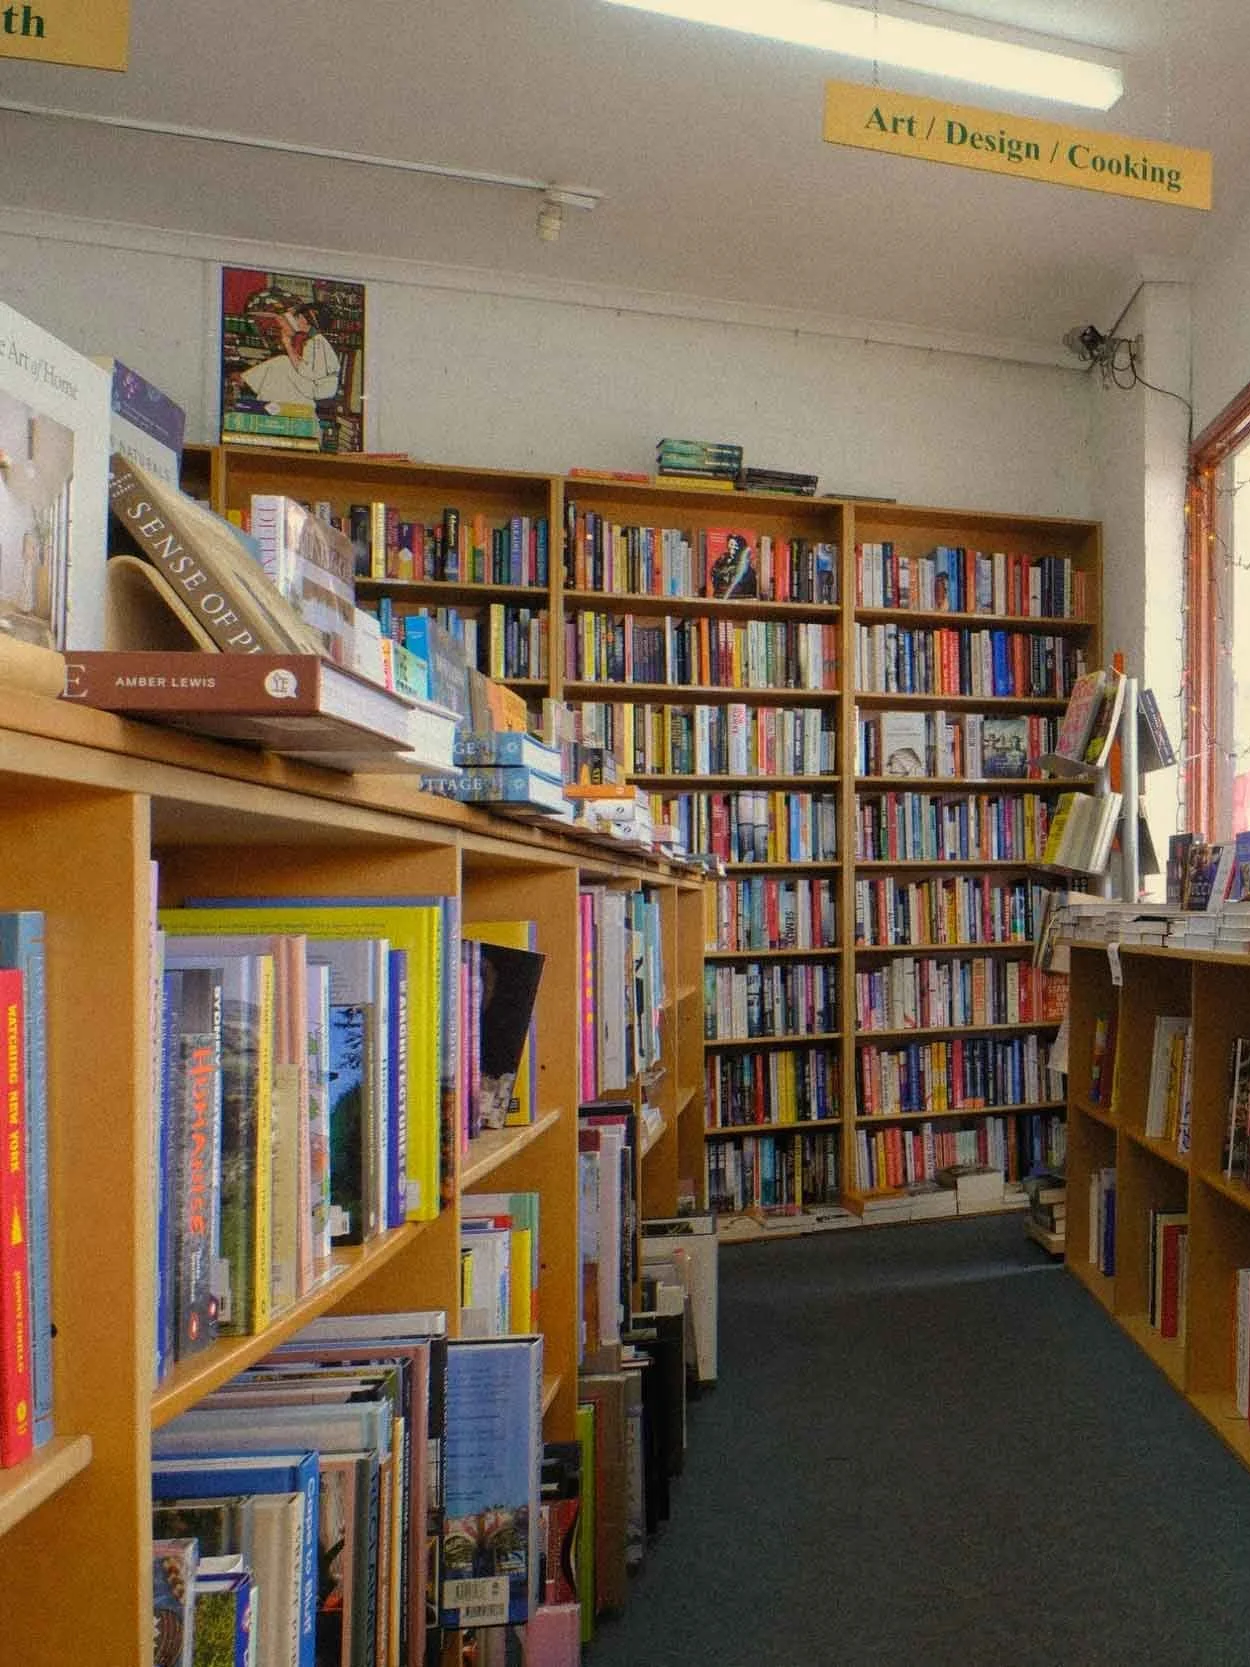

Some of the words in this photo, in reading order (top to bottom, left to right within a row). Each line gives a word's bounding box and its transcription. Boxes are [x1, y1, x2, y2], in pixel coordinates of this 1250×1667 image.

[865, 105, 917, 138] Art
[944, 119, 1041, 164] Design
[1067, 143, 1183, 193] Cooking
[9, 340, 29, 371] Art
[45, 362, 80, 402] Home
[127, 501, 208, 592] SENSE
[200, 592, 239, 629] OF
[115, 677, 165, 688] AMBER
[171, 677, 216, 688] LEWIS
[8, 1004, 18, 1082] WATCHING
[9, 1089, 19, 1122] NEW
[9, 1127, 20, 1174] YORK
[187, 1046, 214, 1236] HUMANISE
[303, 1477, 317, 1540] Cape
[304, 1549, 314, 1574] to
[302, 1579, 315, 1635] Bluff
